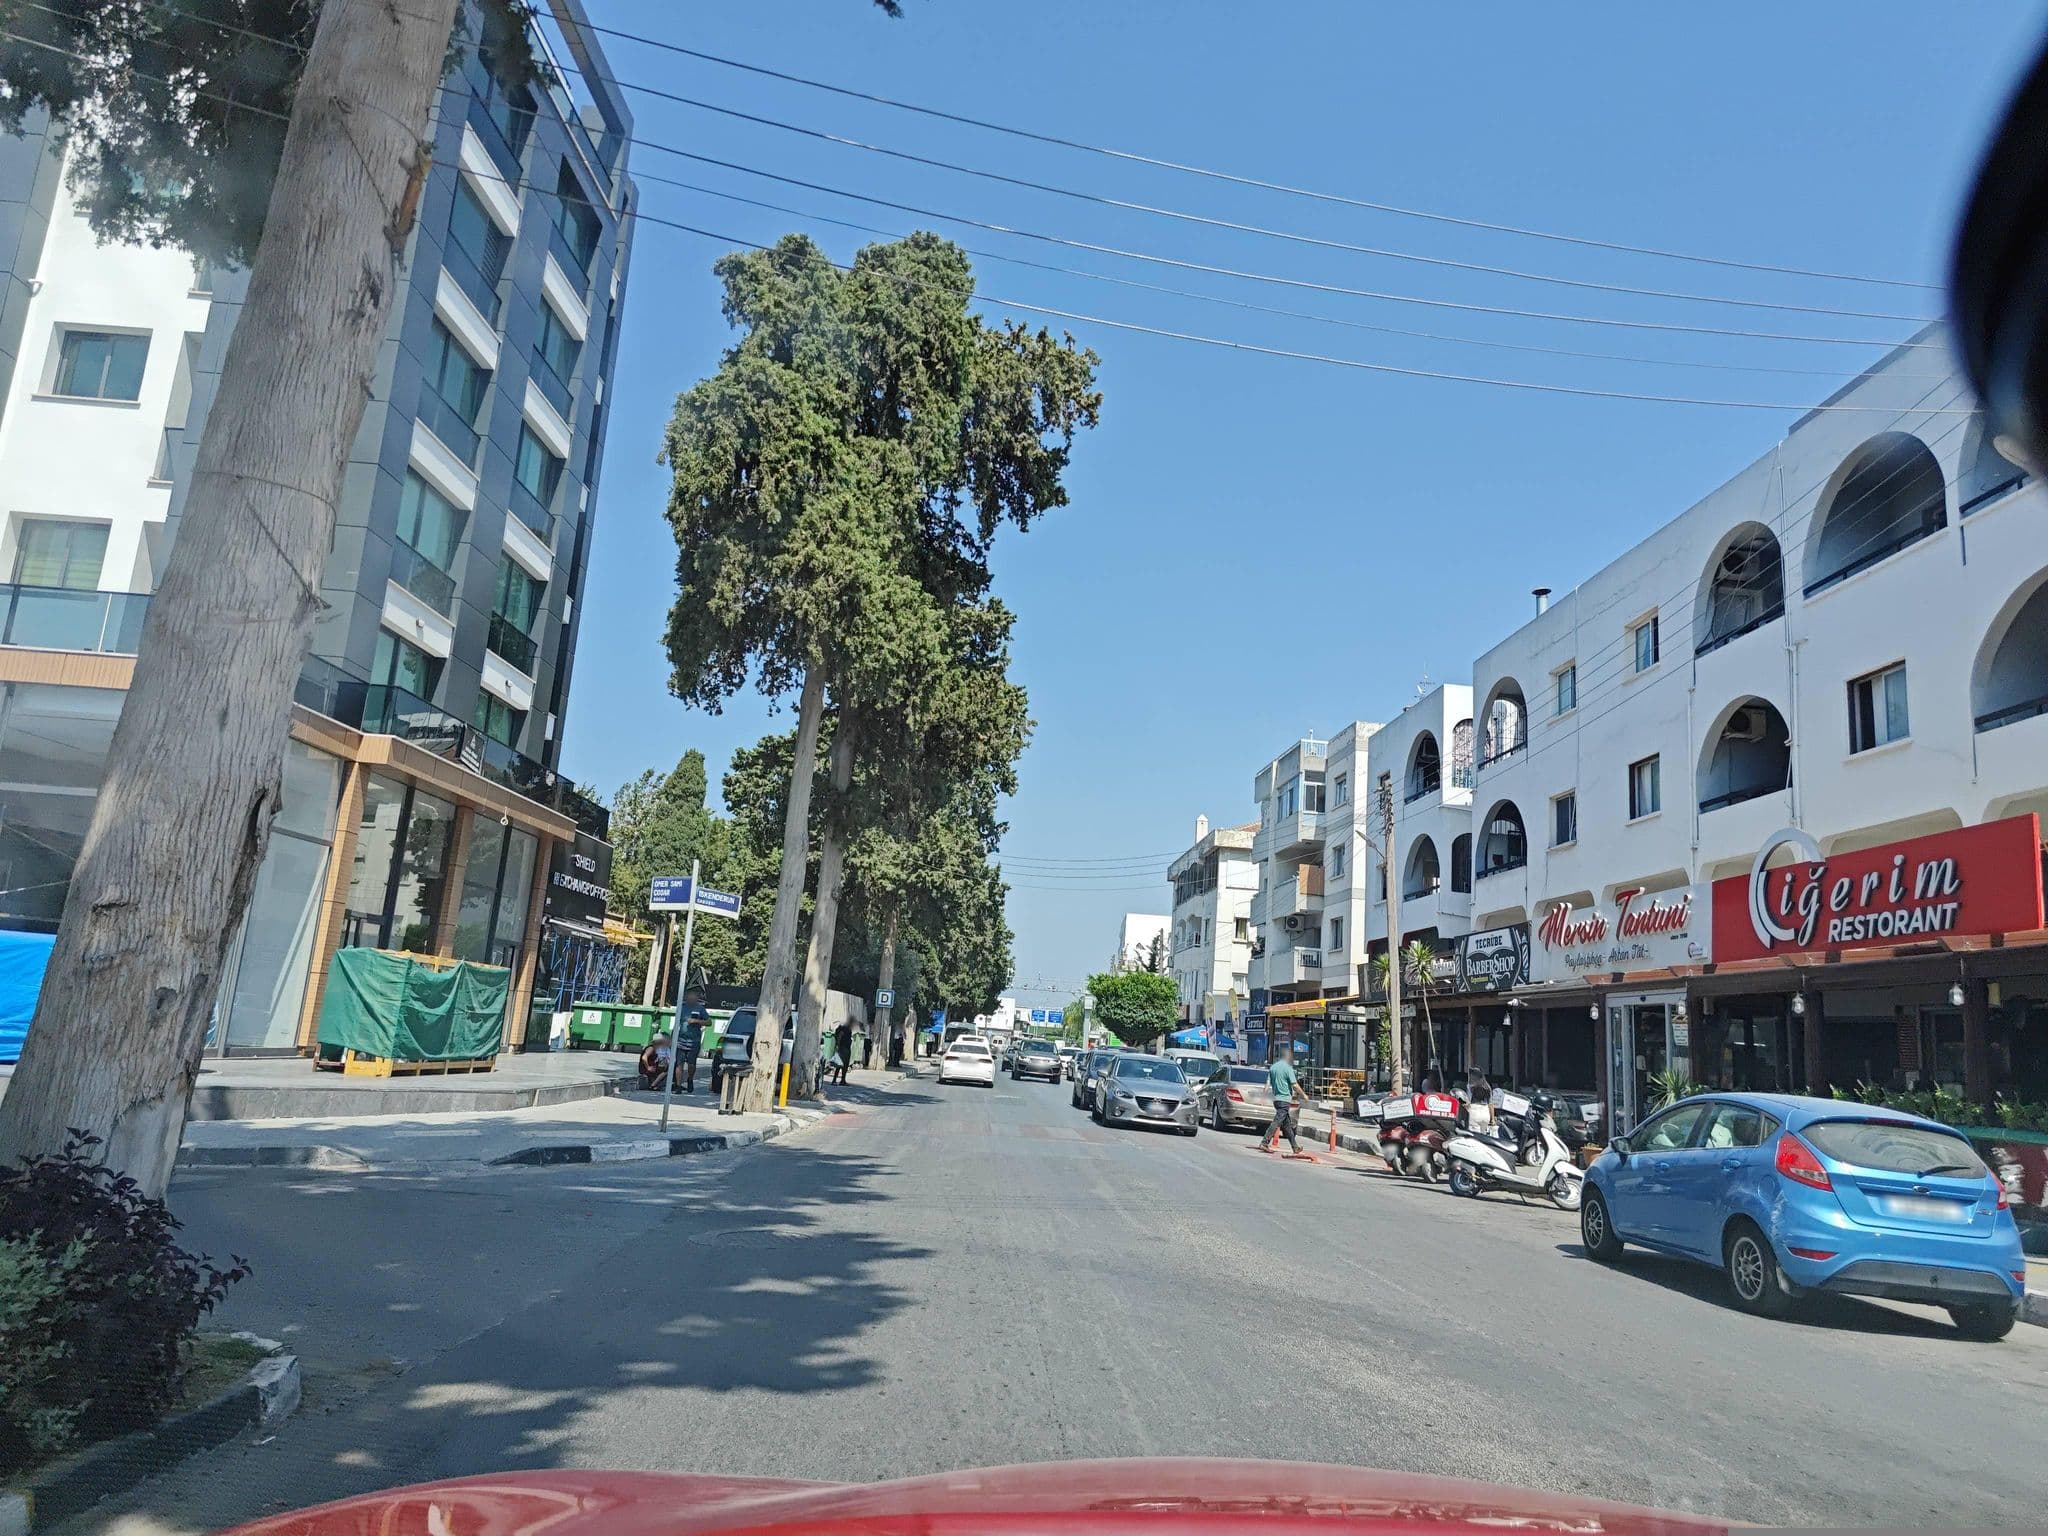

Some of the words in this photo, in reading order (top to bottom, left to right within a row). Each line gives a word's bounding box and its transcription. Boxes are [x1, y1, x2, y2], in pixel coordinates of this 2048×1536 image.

[575, 854, 596, 873] SHIELD
[560, 874, 589, 896] EXCHANGE
[1749, 828, 1961, 949] Ciğerim
[1538, 902, 1609, 953] Mersin
[1615, 886, 1692, 942] Tantuni
[1828, 902, 1959, 944] RESTORANT
[881, 994, 888, 1002] D
